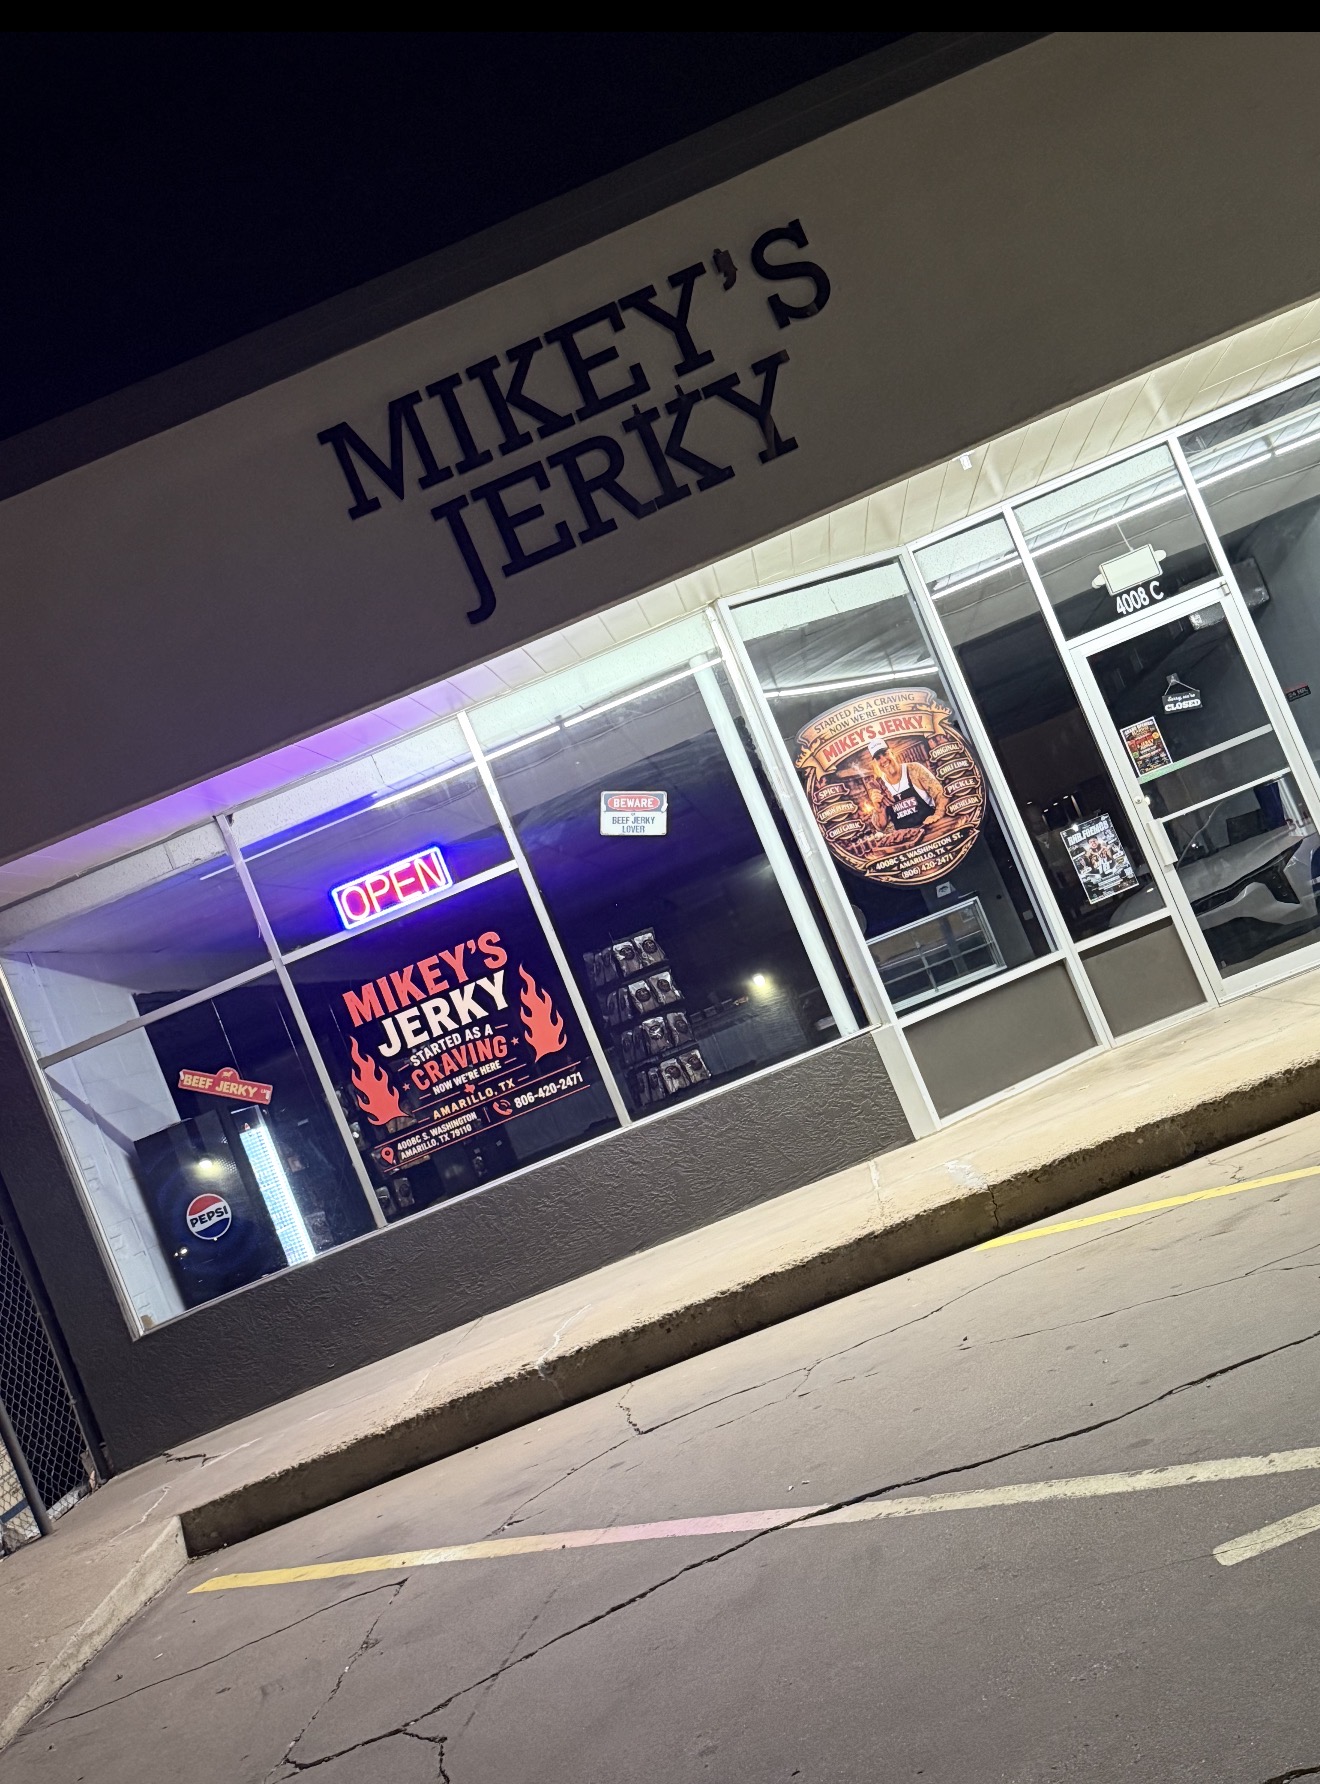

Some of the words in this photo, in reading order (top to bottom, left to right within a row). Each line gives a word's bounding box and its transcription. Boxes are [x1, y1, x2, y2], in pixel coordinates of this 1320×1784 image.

[317, 218, 832, 521] MIKEY'S
[430, 348, 799, 625] JERKY
[1116, 587, 1150, 615] 4008
[1149, 580, 1165, 600] C
[814, 709, 851, 733] STARTED
[853, 703, 865, 713] AS
[866, 701, 873, 710] A
[874, 694, 915, 707] CRAVING
[829, 720, 850, 735] NOW
[850, 711, 878, 724] WE'RE
[879, 704, 901, 715] HERE
[1164, 699, 1201, 712] CLOSED
[822, 725, 876, 763] MIKEY'S
[877, 715, 924, 736] JERKY
[932, 743, 960, 758] ORIGINAL
[939, 763, 954, 775] CHILI
[954, 760, 969, 770] LIME
[613, 798, 654, 808] BEWARE
[818, 786, 840, 798] SPICY
[947, 779, 976, 794] PICKLE
[612, 816, 630, 824] BEEF
[631, 816, 655, 824] JERKY
[819, 807, 837, 820] LEMON
[949, 797, 979, 812] MICHELADA
[622, 825, 645, 833] LOVER
[829, 826, 844, 837] CHILI
[876, 858, 899, 871] 4008C
[899, 854, 907, 863] S.
[907, 837, 952, 859] WASHINGTON
[952, 833, 964, 843] ST.
[899, 852, 936, 869] AMARILLO,
[935, 846, 946, 856] TX
[901, 864, 921, 879] (806)
[921, 853, 954, 871] 420-2471
[340, 851, 447, 922] OPEN
[342, 931, 508, 1028] MIKEY'S
[378, 969, 509, 1058] JERKY
[410, 1034, 462, 1067] STARTED
[464, 1027, 482, 1042] AS
[483, 1023, 494, 1036] A
[411, 1035, 508, 1091] CRAVING
[432, 1079, 453, 1096] NOW
[453, 1070, 480, 1087] WE'RE
[479, 1060, 502, 1076] HERE
[183, 1074, 214, 1090] BEEF
[215, 1080, 258, 1098] JERKY
[433, 1087, 498, 1120] AMARILLO,
[498, 1078, 516, 1092] TX
[513, 1072, 584, 1109] 806-420-2471
[397, 1134, 422, 1151] 4008C
[422, 1130, 430, 1141] S.
[430, 1111, 478, 1137] WASHINGTON
[401, 1138, 440, 1160] AMARILLO,
[439, 1132, 450, 1143] TX
[450, 1123, 472, 1140] 79110
[189, 1205, 229, 1228] PEPSI
